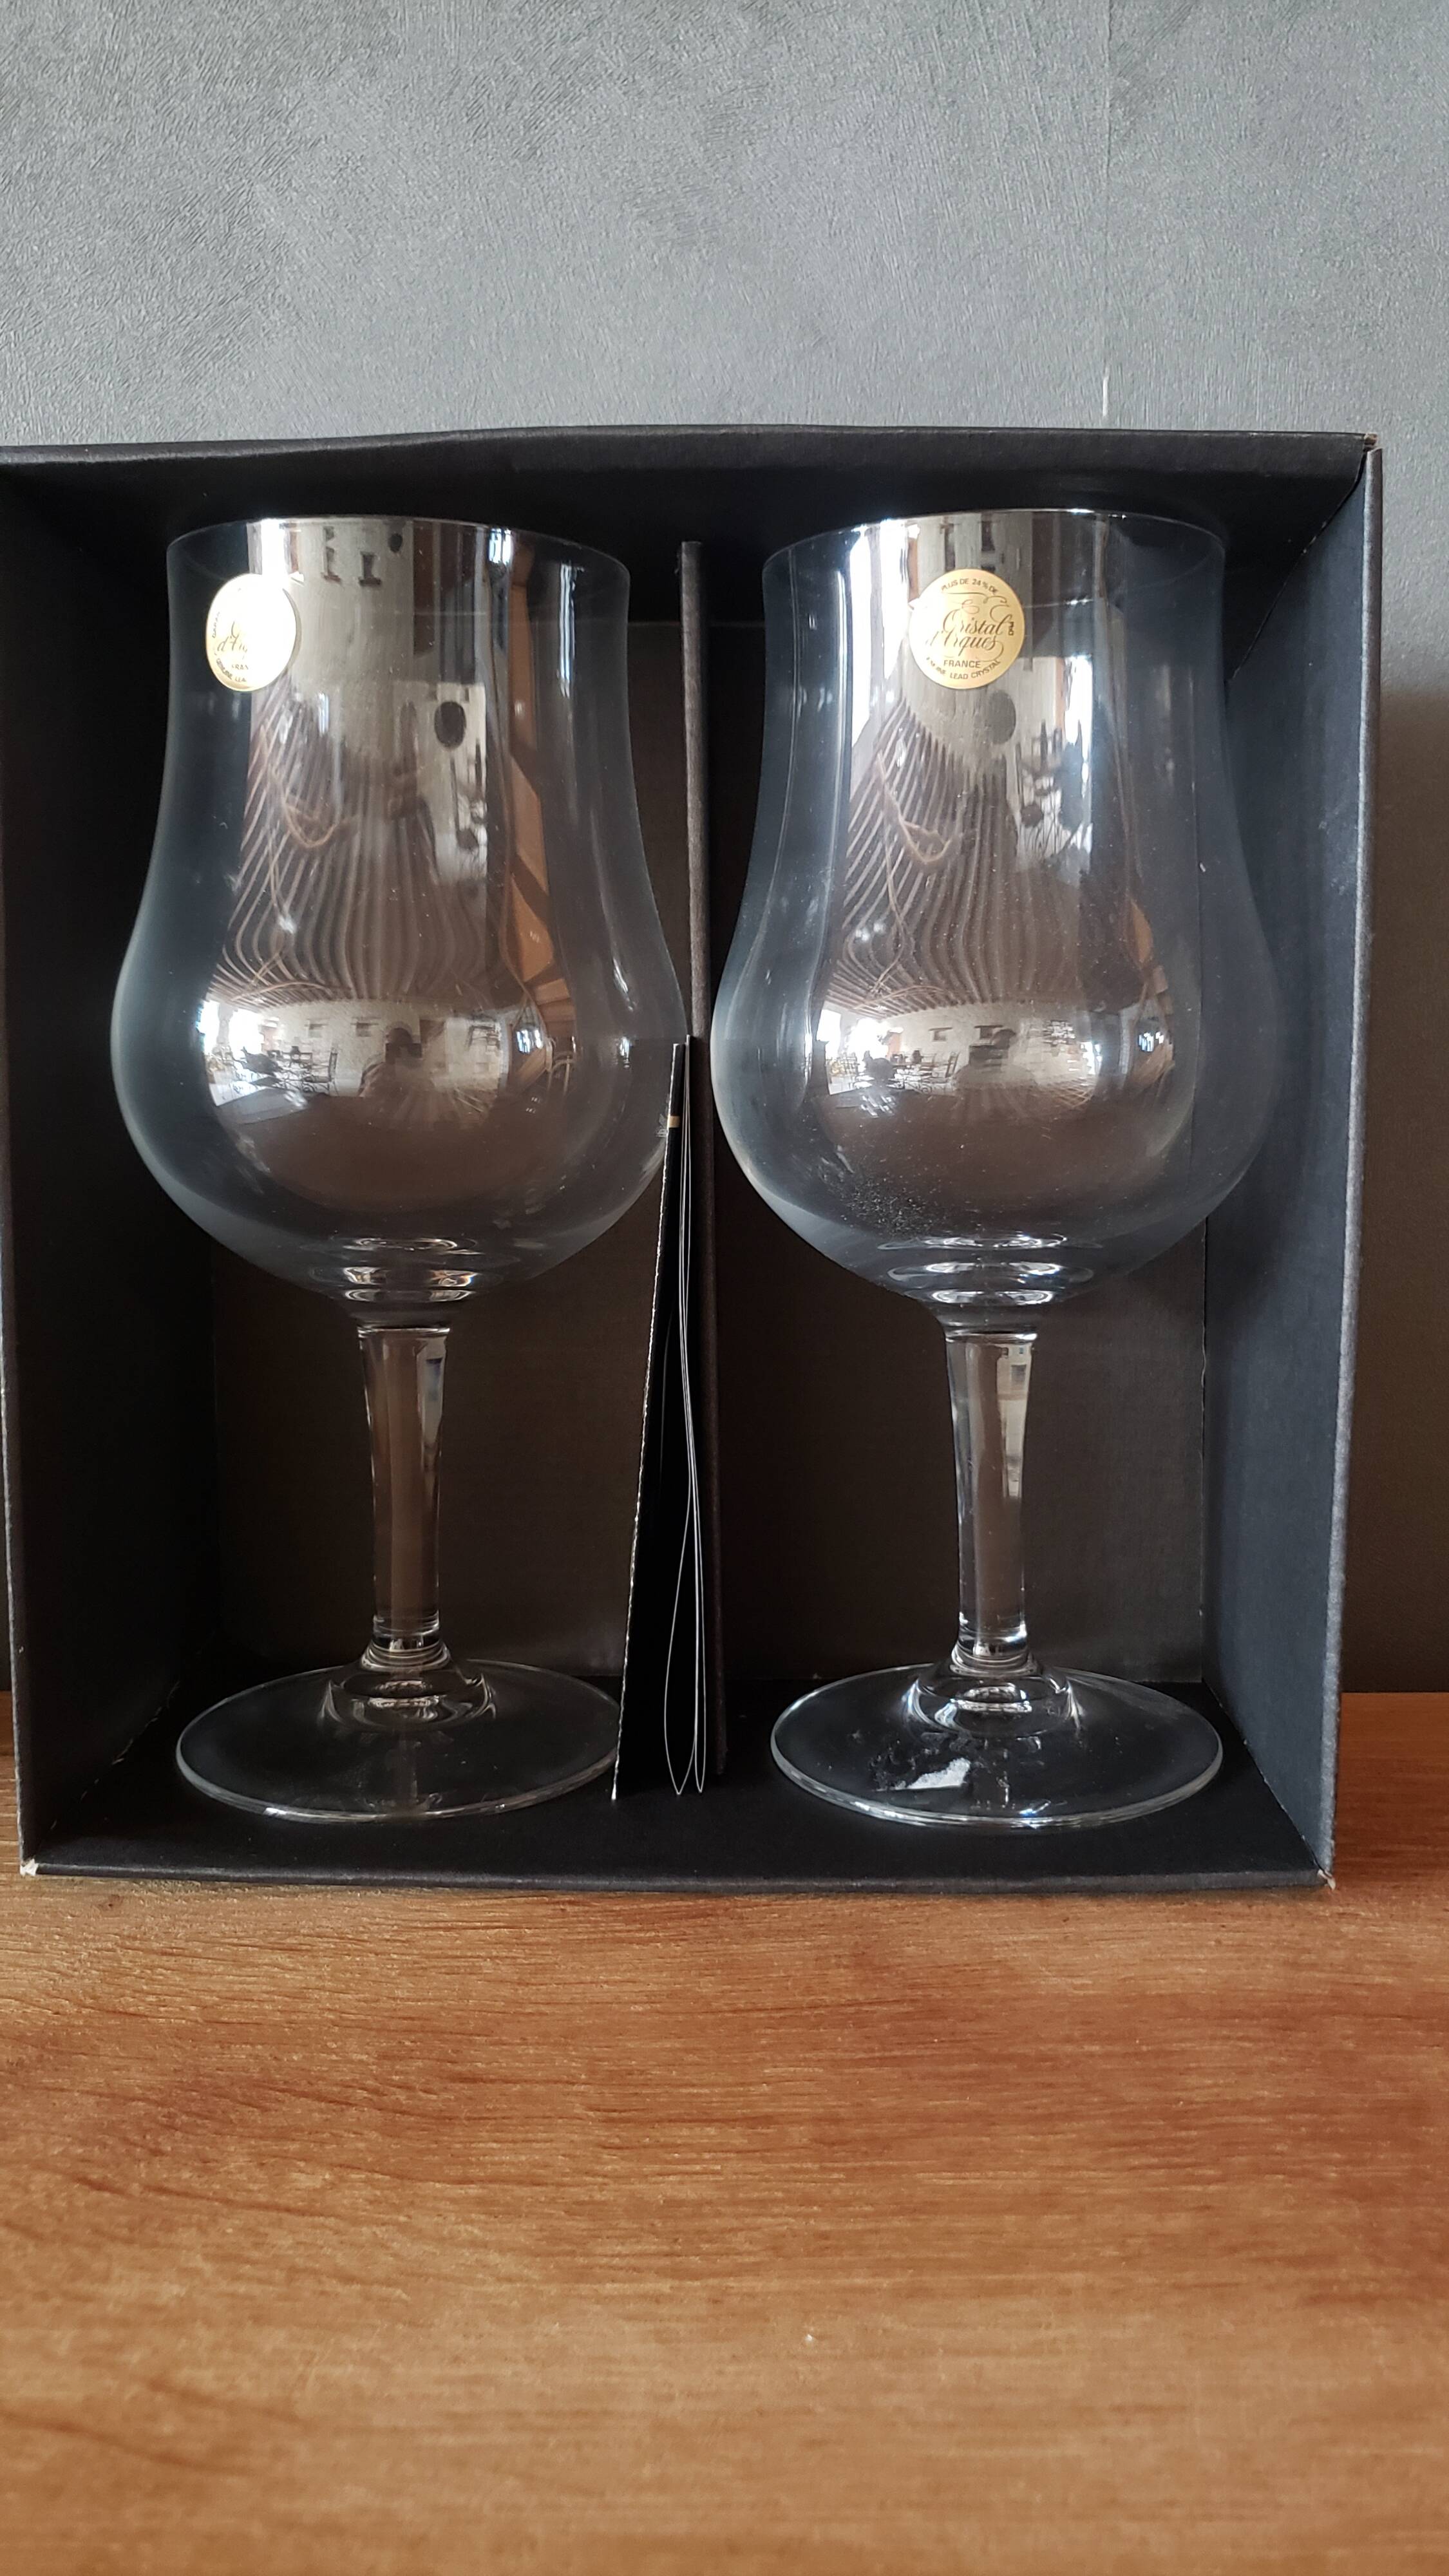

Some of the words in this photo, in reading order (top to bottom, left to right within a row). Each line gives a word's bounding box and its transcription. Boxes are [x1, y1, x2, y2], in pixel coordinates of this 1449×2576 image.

[942, 580, 958, 591] PLUS
[943, 608, 1012, 636] Cristal
[943, 659, 981, 668] FRANCE
[971, 660, 1001, 679] CRYSTAL
